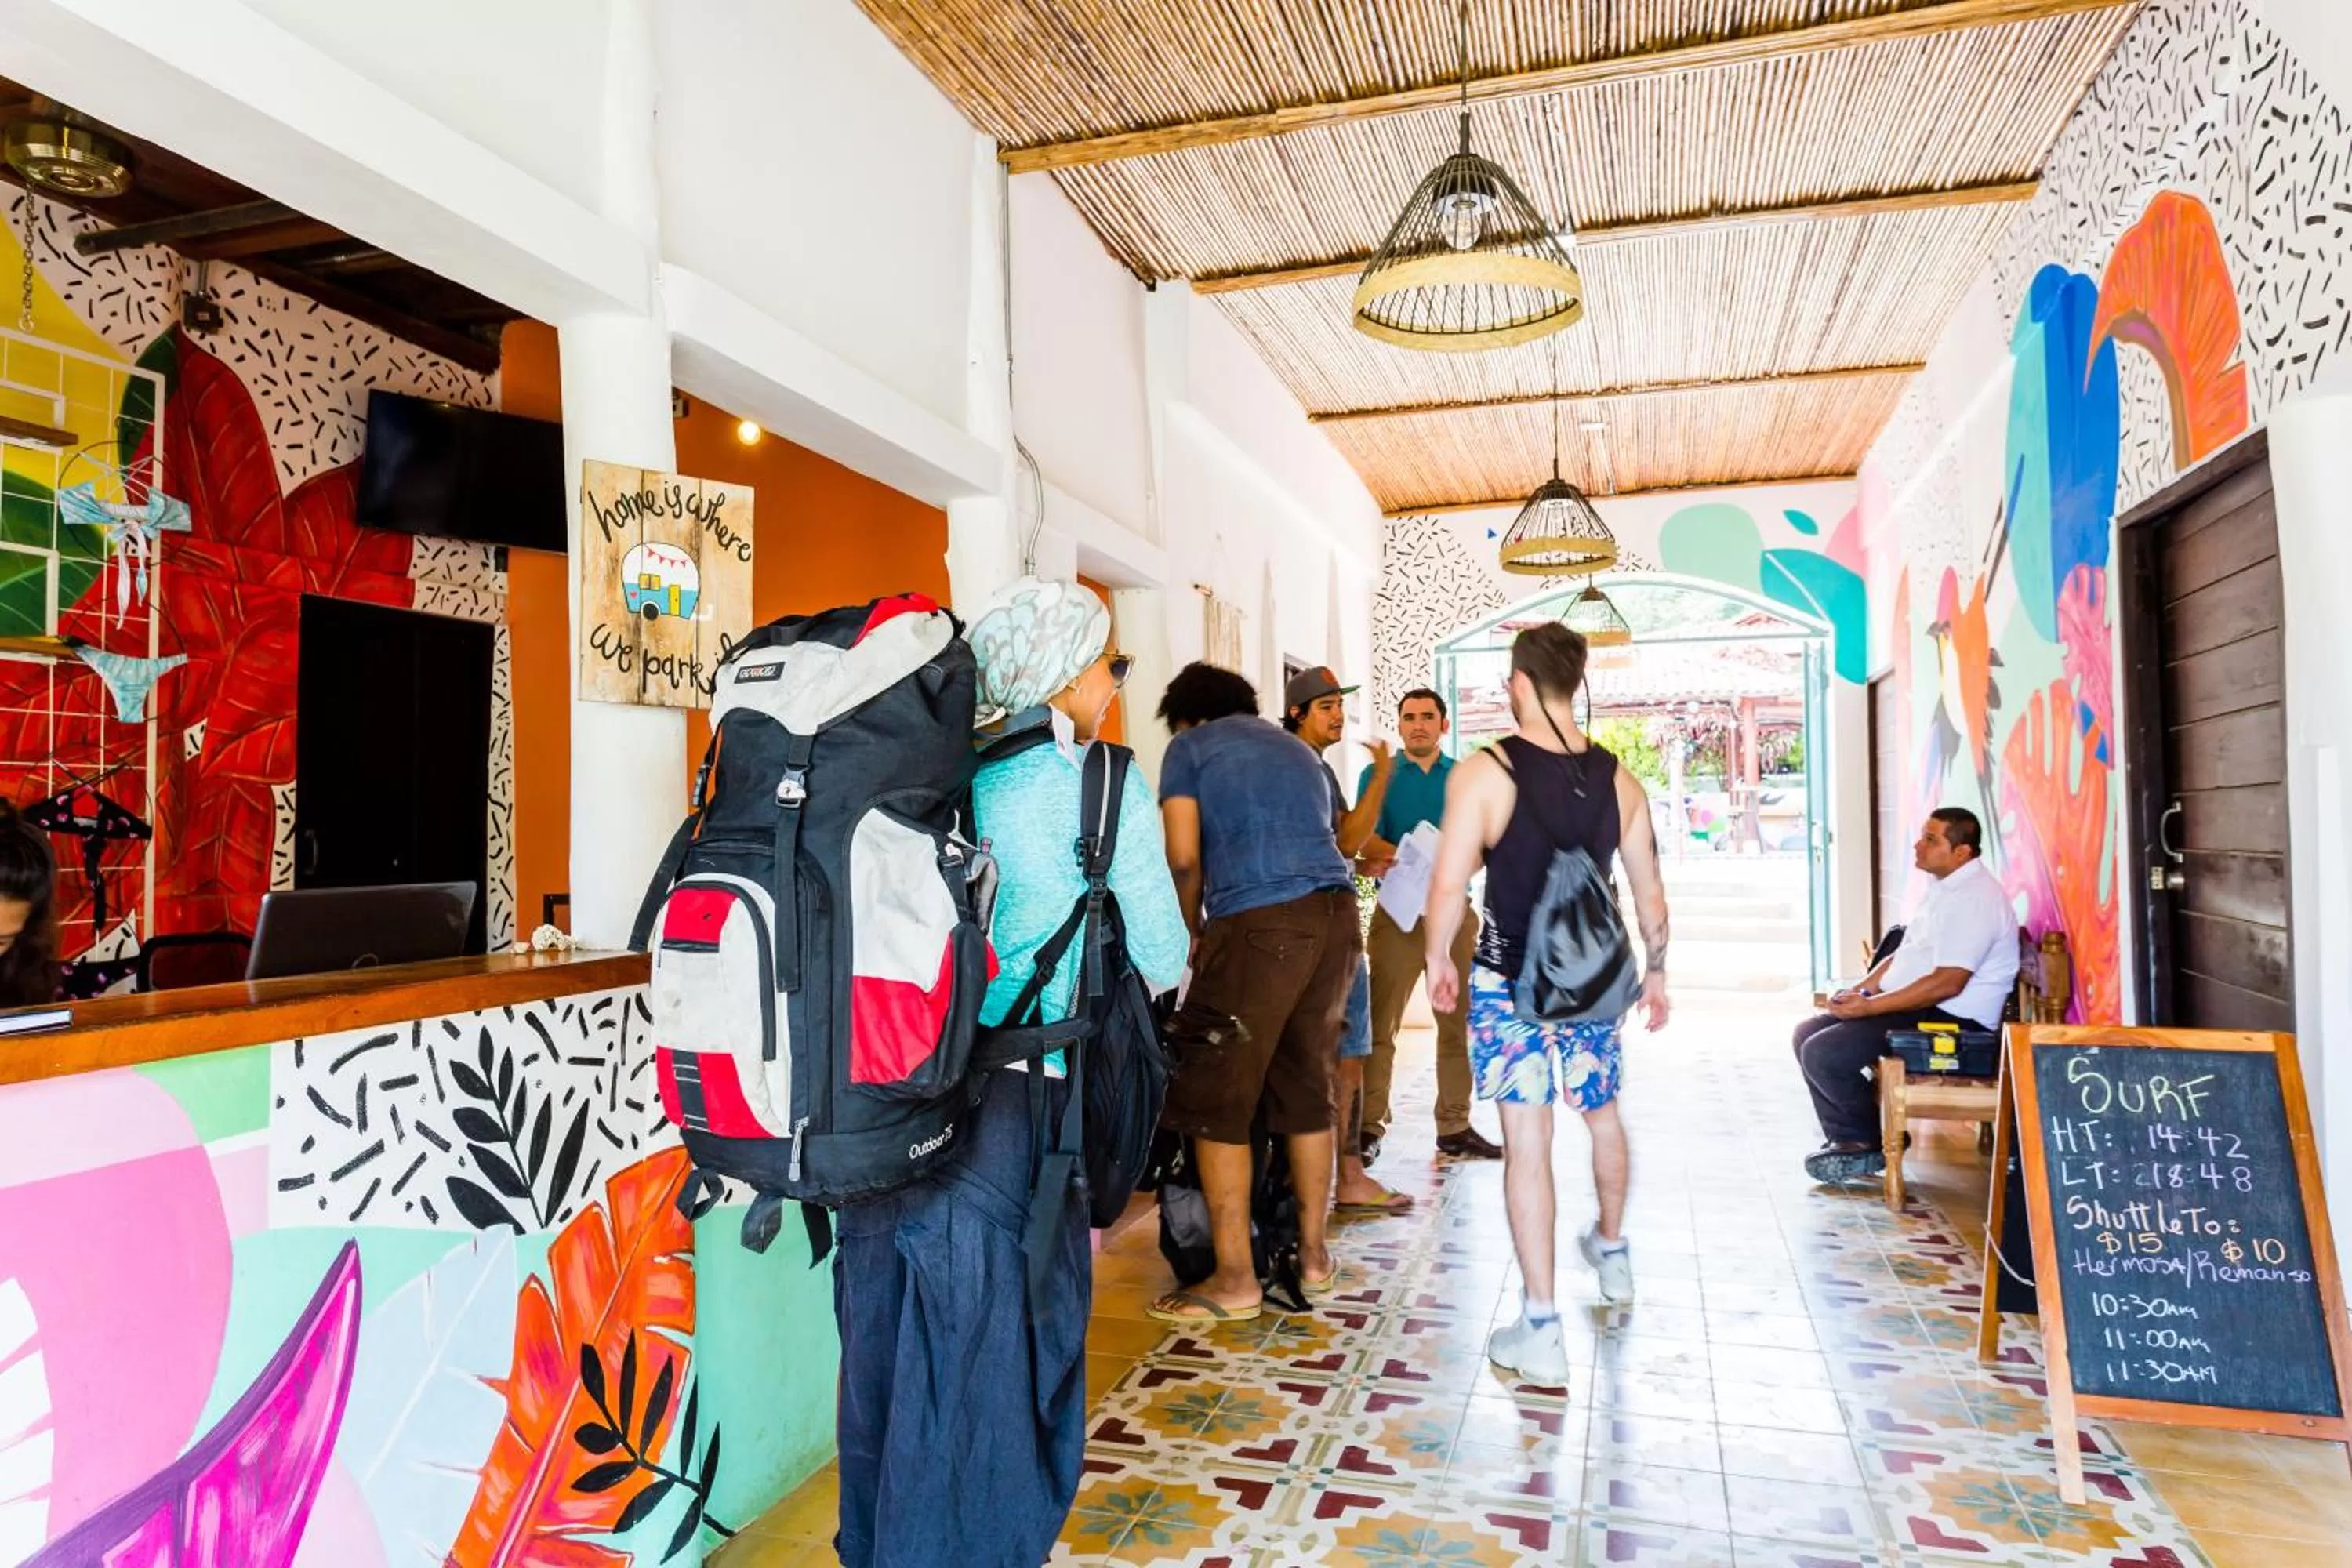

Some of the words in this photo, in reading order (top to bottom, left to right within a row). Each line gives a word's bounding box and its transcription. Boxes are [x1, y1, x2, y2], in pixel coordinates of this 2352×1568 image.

[587, 490, 665, 543] home
[664, 481, 683, 519] is
[686, 492, 752, 562] where
[642, 648, 713, 695] park
[2067, 1056, 2215, 1121] SURF
[909, 1134, 945, 1160] Outdoor
[2051, 1116, 2113, 1153] HT:
[2147, 1123, 2250, 1160] 14:42
[2061, 1161, 2122, 1190] LT:
